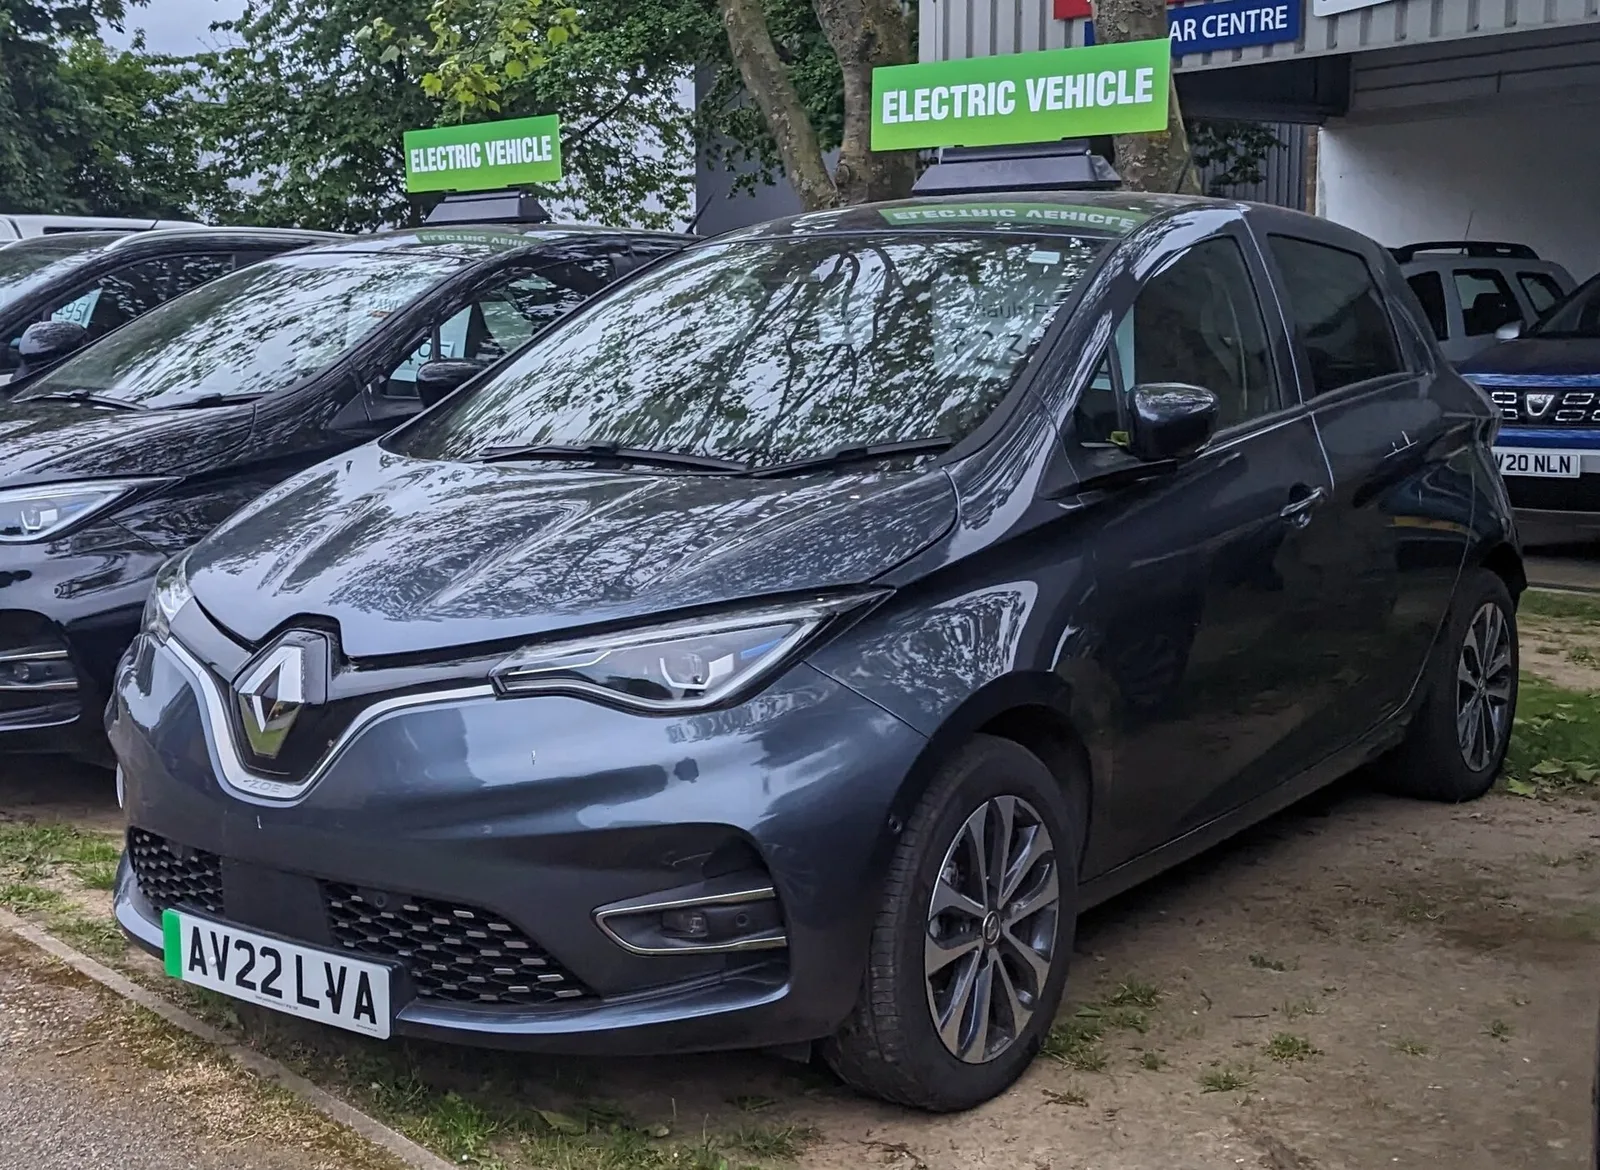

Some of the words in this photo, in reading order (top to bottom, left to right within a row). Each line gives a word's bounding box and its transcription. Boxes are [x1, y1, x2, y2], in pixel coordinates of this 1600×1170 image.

[1169, 19, 1197, 42] AR
[1201, 5, 1288, 39] CENTRE
[882, 80, 1016, 124] ELECTRIC
[1026, 67, 1154, 112] VEHICLE
[410, 142, 482, 173] ELECTRIC
[484, 135, 552, 167] VEHICLE
[1495, 453, 1529, 472] V20
[1534, 455, 1571, 474] NLN
[248, 779, 283, 794] ZOE
[187, 925, 283, 999] AV22
[295, 954, 378, 1025] LVA
